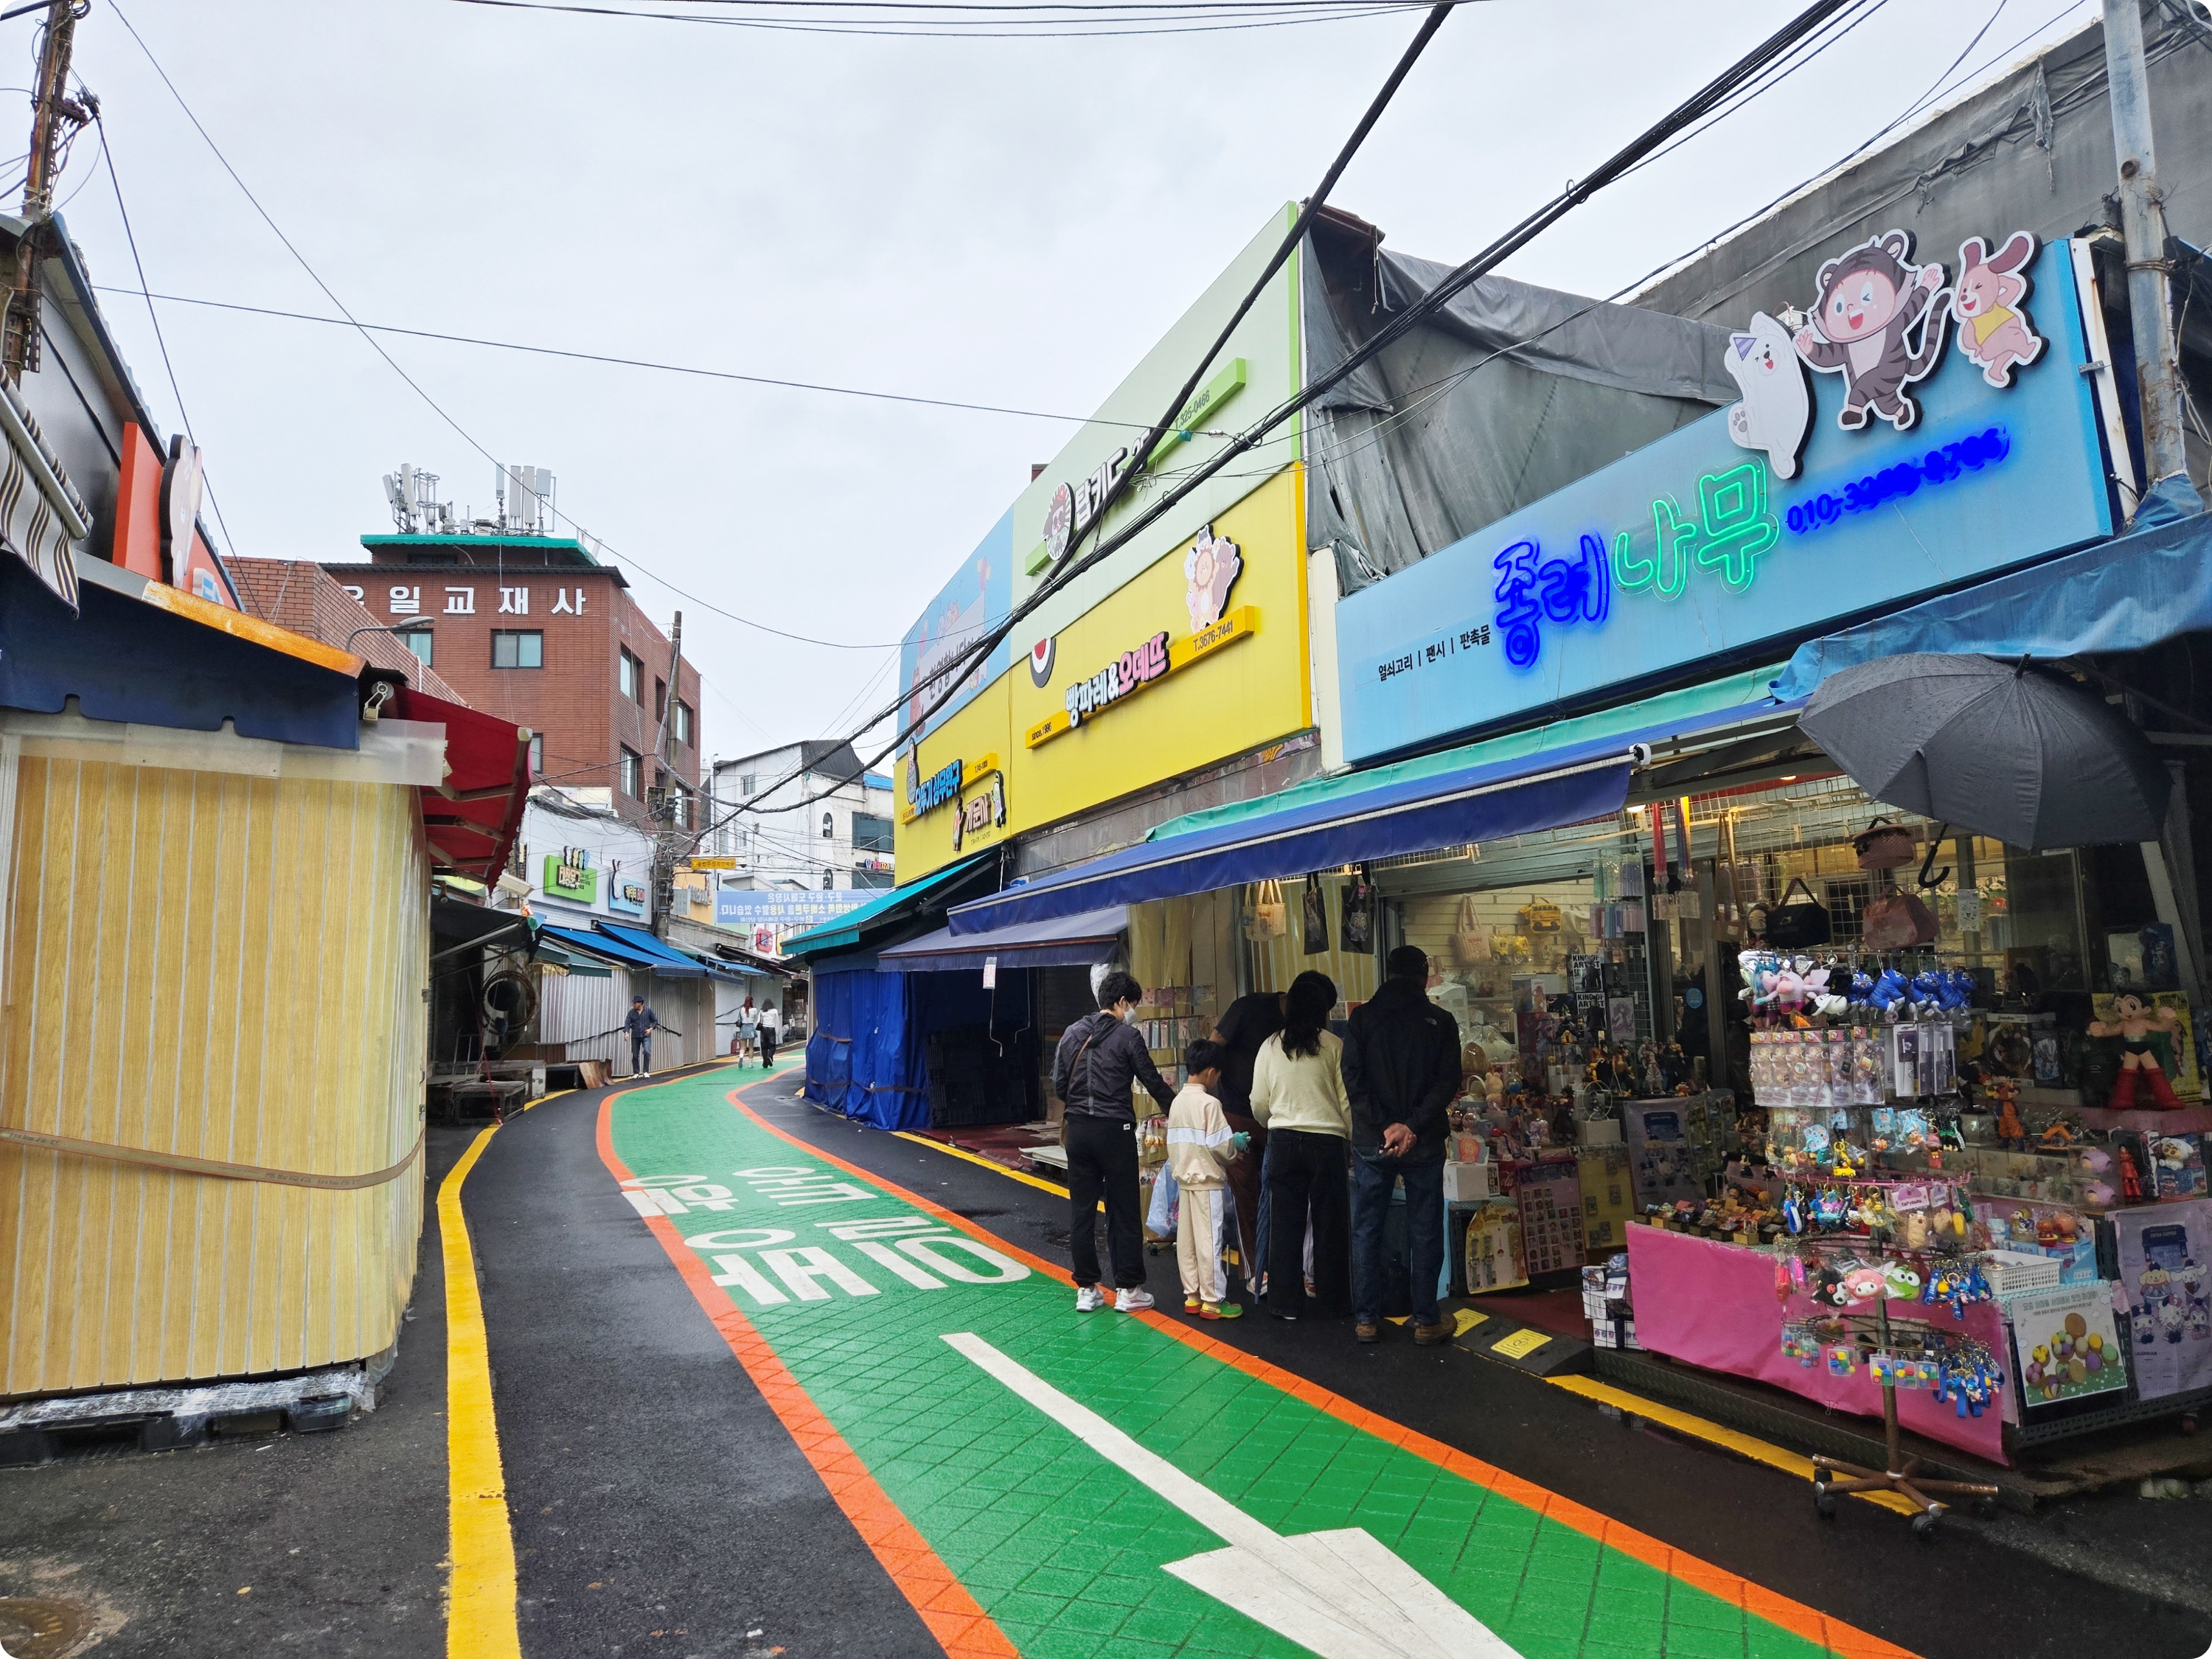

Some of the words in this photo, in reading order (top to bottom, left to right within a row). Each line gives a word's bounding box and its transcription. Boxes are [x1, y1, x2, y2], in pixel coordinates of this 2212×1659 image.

[1193, 619, 1234, 653] T.3676-7441
[1378, 653, 1413, 682] 열쇠고리
[1426, 641, 1446, 663] 팬시
[1459, 624, 1491, 650] 판촉물
[915, 777, 933, 817] 오뚜기
[619, 1166, 879, 1217] 통행
[683, 1215, 1032, 1306] 일방
